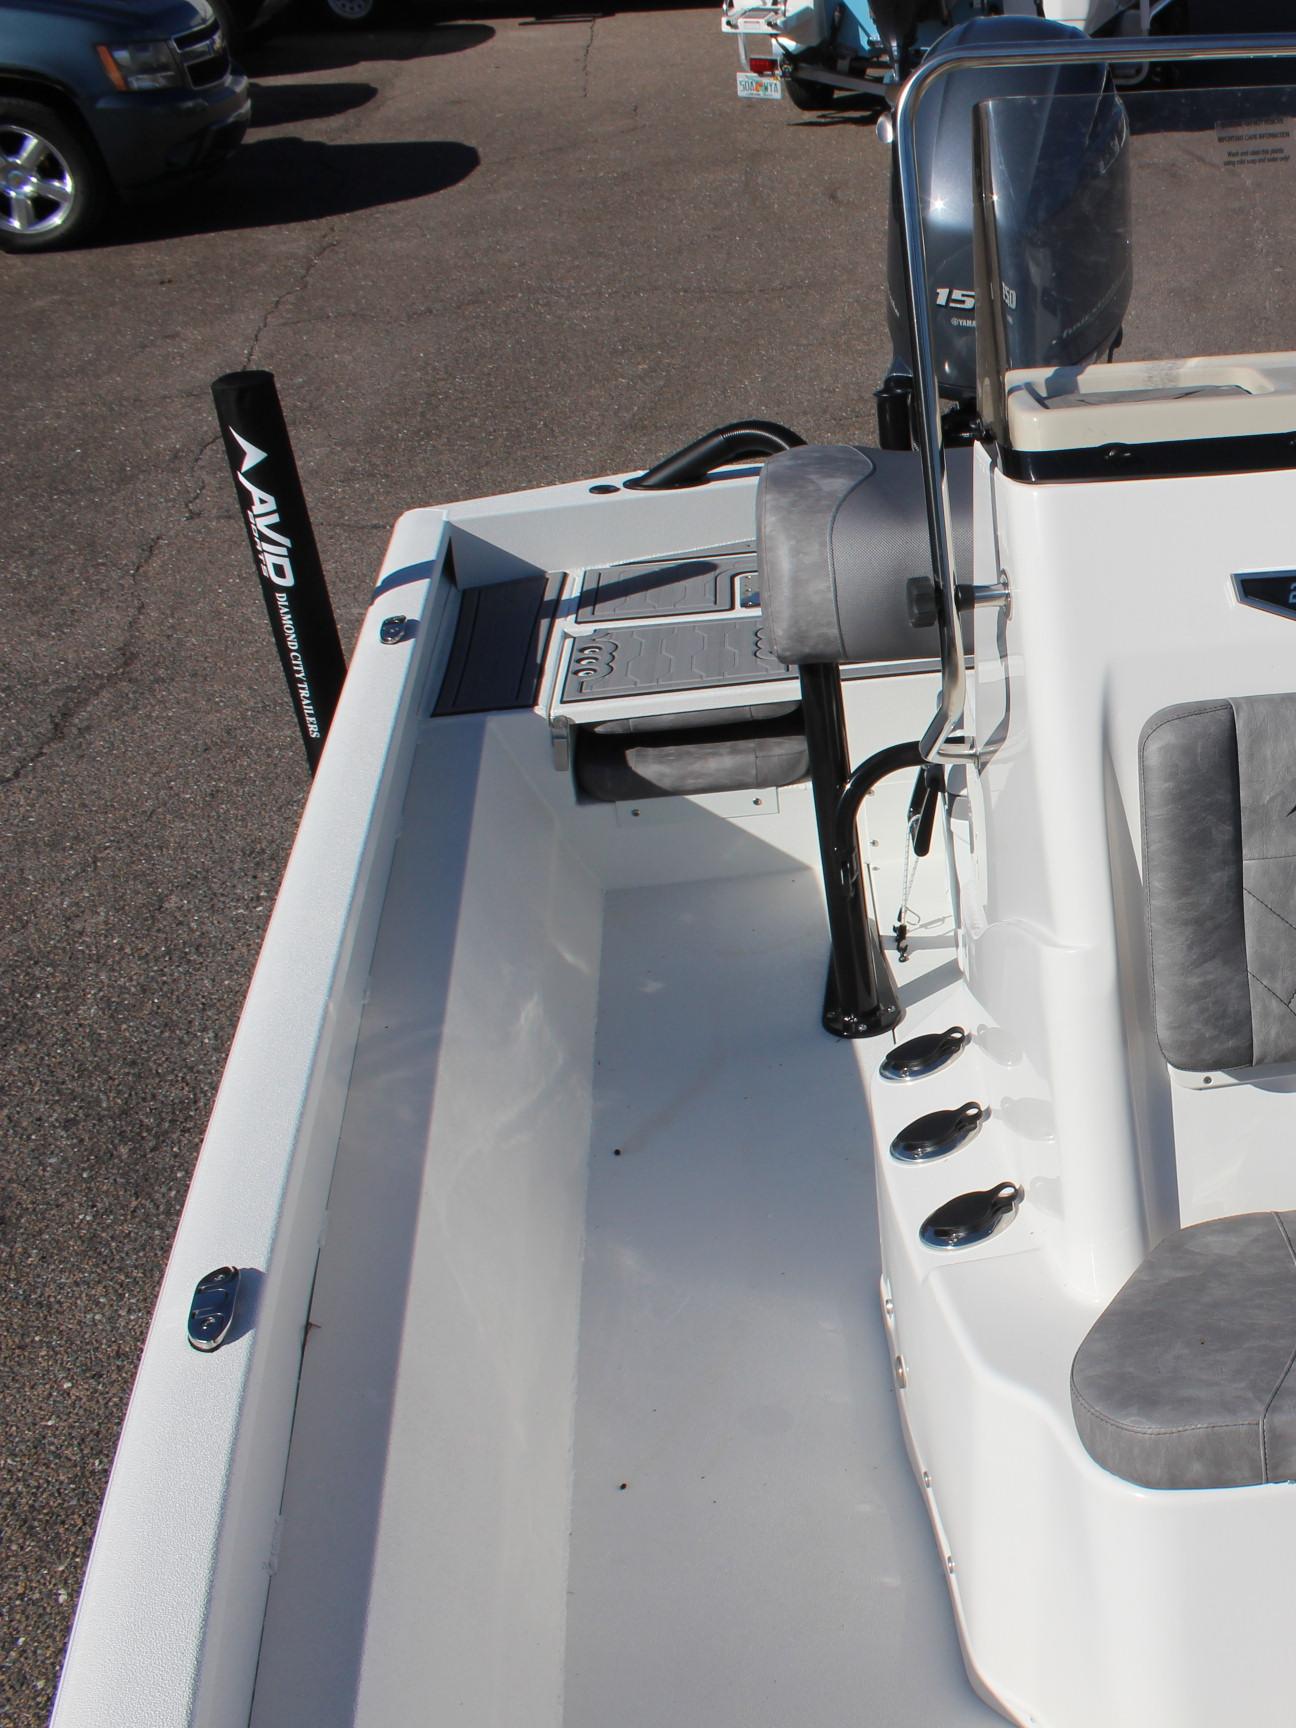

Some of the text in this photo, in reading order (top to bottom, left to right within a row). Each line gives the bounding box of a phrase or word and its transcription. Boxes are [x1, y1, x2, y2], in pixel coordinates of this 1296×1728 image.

[936, 287, 977, 309] 15
[237, 471, 295, 588] AVID
[275, 592, 321, 739] DIAMOND CITY TRAILERS
